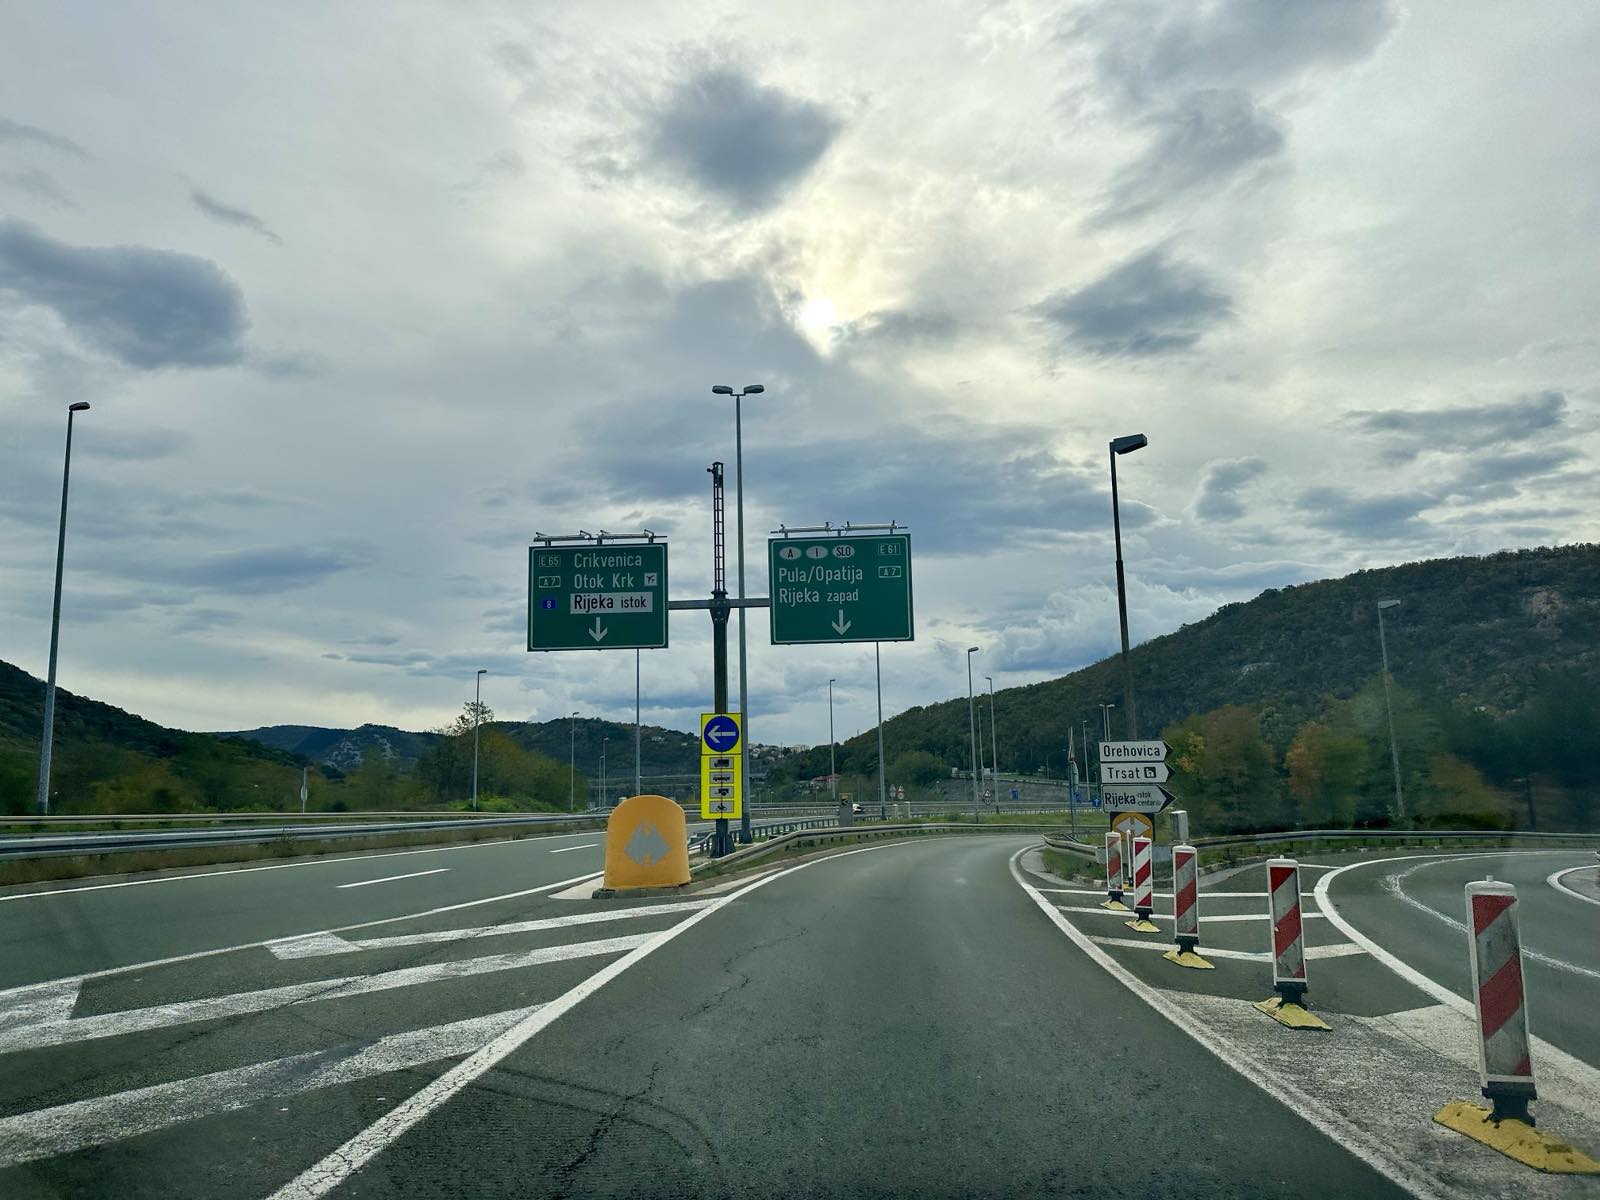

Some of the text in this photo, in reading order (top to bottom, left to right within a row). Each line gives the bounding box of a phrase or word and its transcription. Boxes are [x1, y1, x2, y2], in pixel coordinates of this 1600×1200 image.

[787, 549, 794, 558] A
[836, 546, 851, 557] SLO
[880, 544, 897, 554] E 61
[541, 556, 559, 566] E 65
[574, 553, 642, 568] Crikvenica
[779, 565, 863, 584] Pula/Opatija
[884, 567, 897, 576] A 7
[543, 578, 549, 586] A
[574, 573, 635, 588] Otok Krk
[780, 587, 859, 607] Rijeka zapad
[546, 600, 552, 609] 8
[574, 594, 647, 613] Rijeka istok
[1103, 745, 1160, 757] Orehovica
[1107, 767, 1140, 779] Trsat
[1104, 792, 1136, 807] Rijeka
